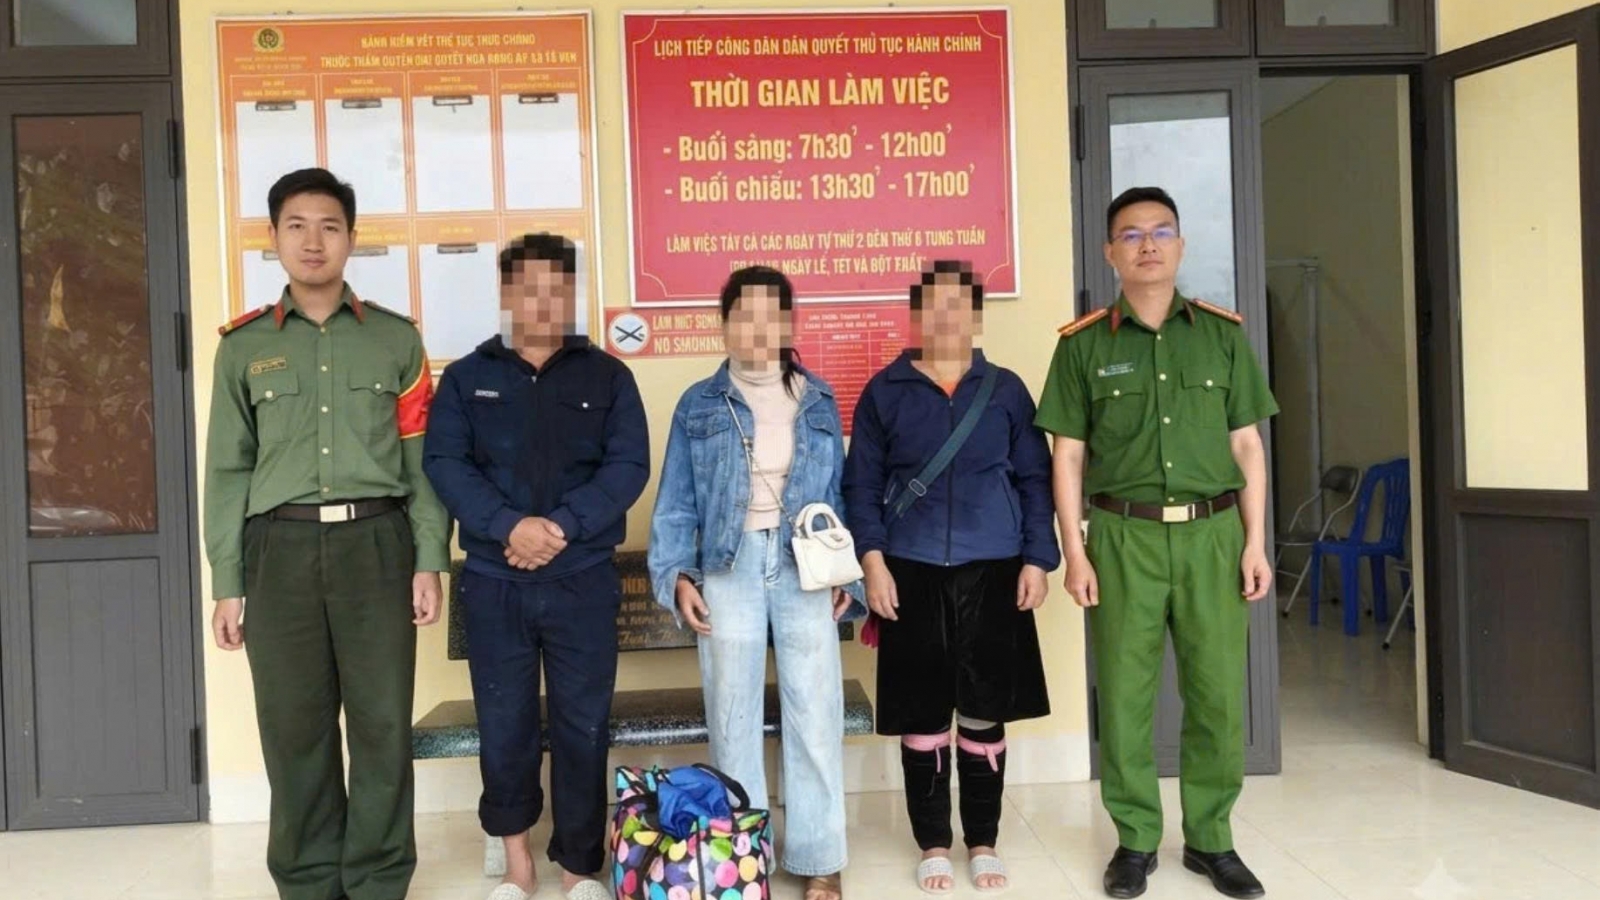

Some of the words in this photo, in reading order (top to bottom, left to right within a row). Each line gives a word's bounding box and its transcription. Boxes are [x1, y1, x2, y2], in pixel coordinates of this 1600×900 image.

[654, 39, 682, 60] LỊCH
[685, 33, 713, 57] TIẾP
[716, 36, 750, 56] CÔNG
[811, 31, 849, 56] QUYẾT
[879, 36, 903, 58] TỤC
[690, 72, 750, 108] THỜI
[758, 78, 821, 107] GIAN
[828, 72, 885, 106] LÀM
[891, 71, 950, 110] VIỆC
[856, 232, 864, 249] 2
